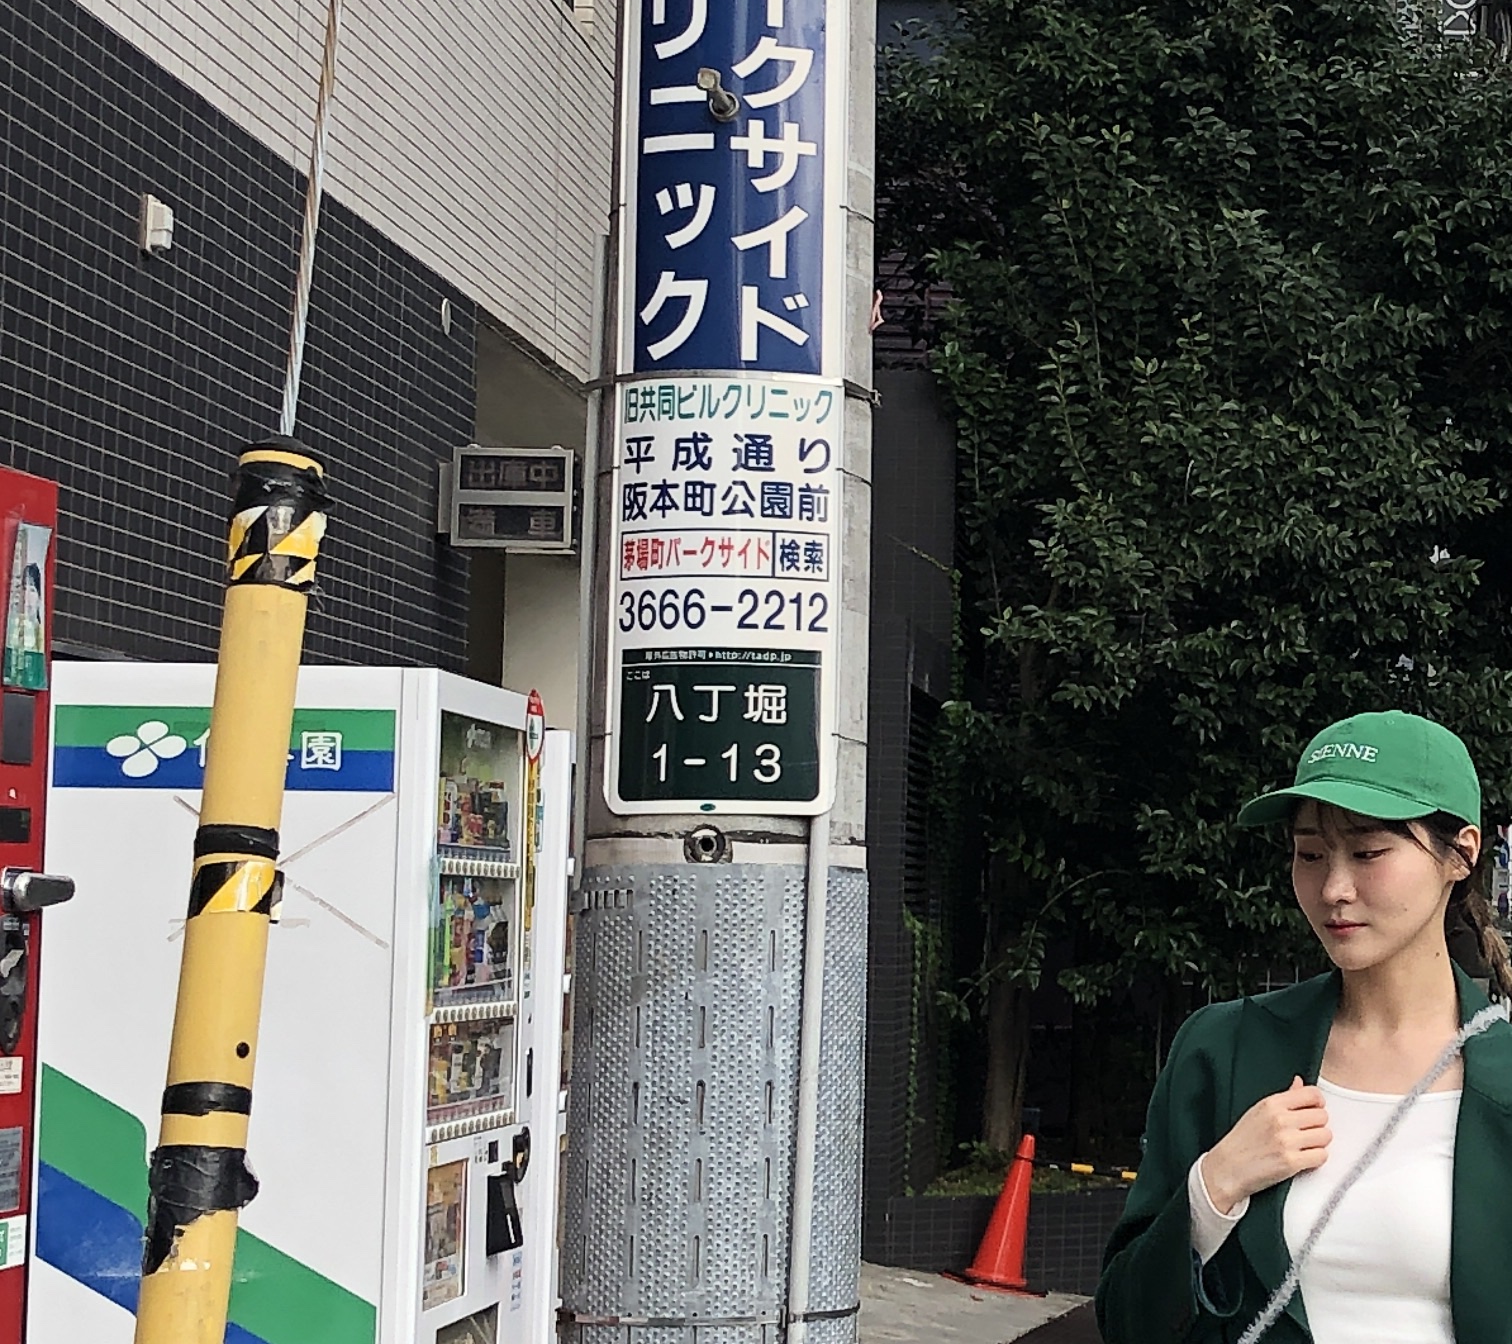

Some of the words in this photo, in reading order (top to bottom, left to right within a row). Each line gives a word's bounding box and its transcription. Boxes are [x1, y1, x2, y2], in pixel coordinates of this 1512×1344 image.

[623, 384, 833, 424] 旧共同ビルクリニック
[624, 431, 831, 474] 平成通り
[621, 479, 830, 523] 阪本町公園前
[623, 536, 770, 571] 茅場町パークサイド
[779, 538, 824, 574] 検索
[618, 588, 828, 633] 3666-2212
[645, 683, 788, 725] 八丁堀
[652, 743, 782, 783] 1-13
